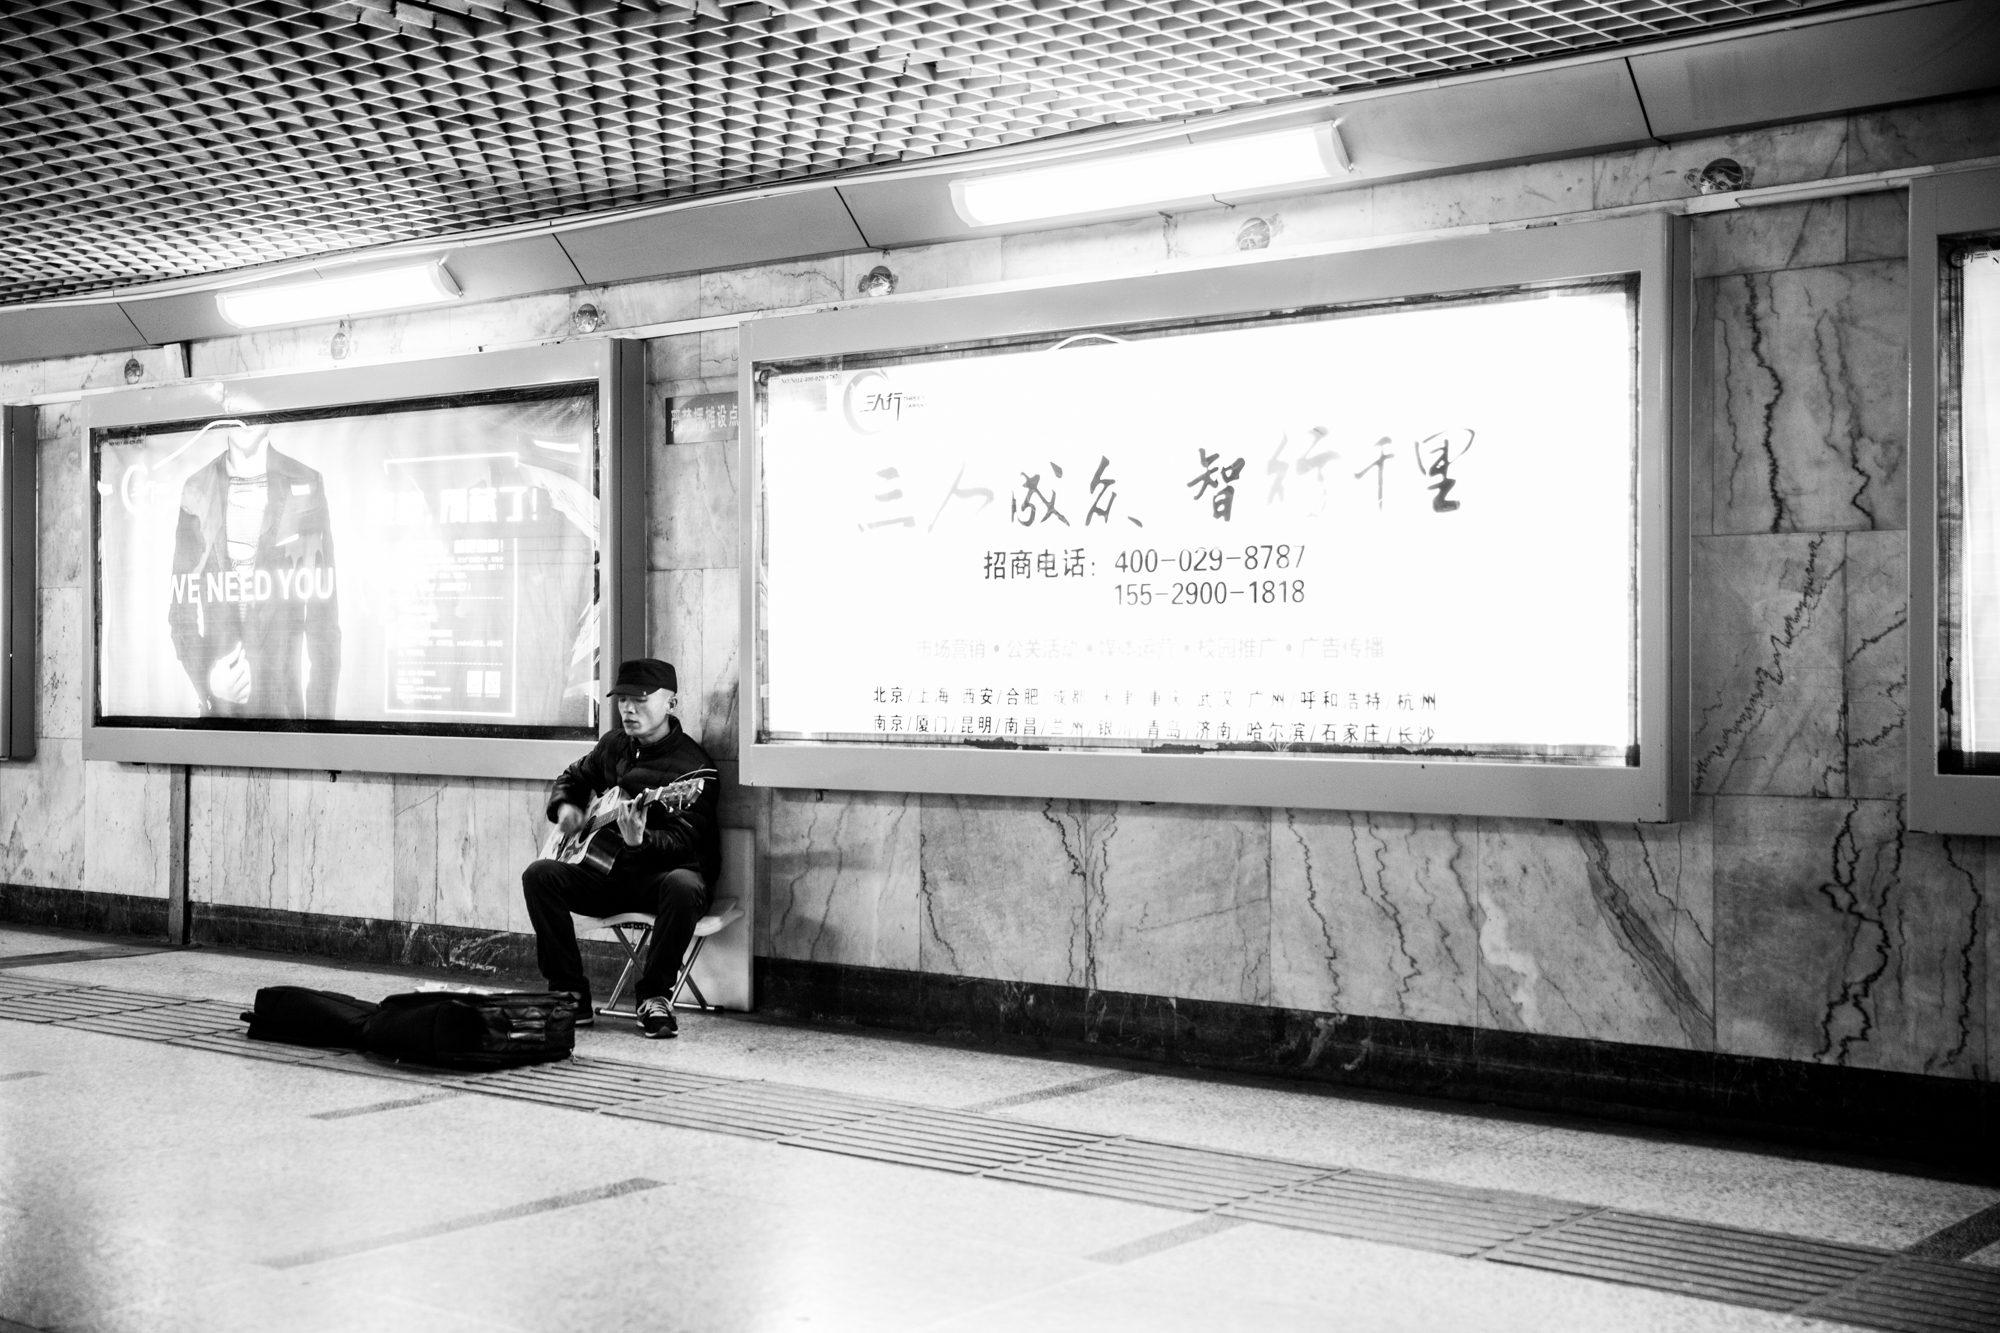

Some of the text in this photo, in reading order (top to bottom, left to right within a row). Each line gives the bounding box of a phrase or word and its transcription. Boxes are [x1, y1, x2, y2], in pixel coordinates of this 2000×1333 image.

[1186, 425, 1476, 523] 智行千里
[1115, 544, 1306, 573] 400-029-8787
[168, 567, 335, 604] WE NEED YOU
[1115, 580, 1305, 607] 155-2900-1818
